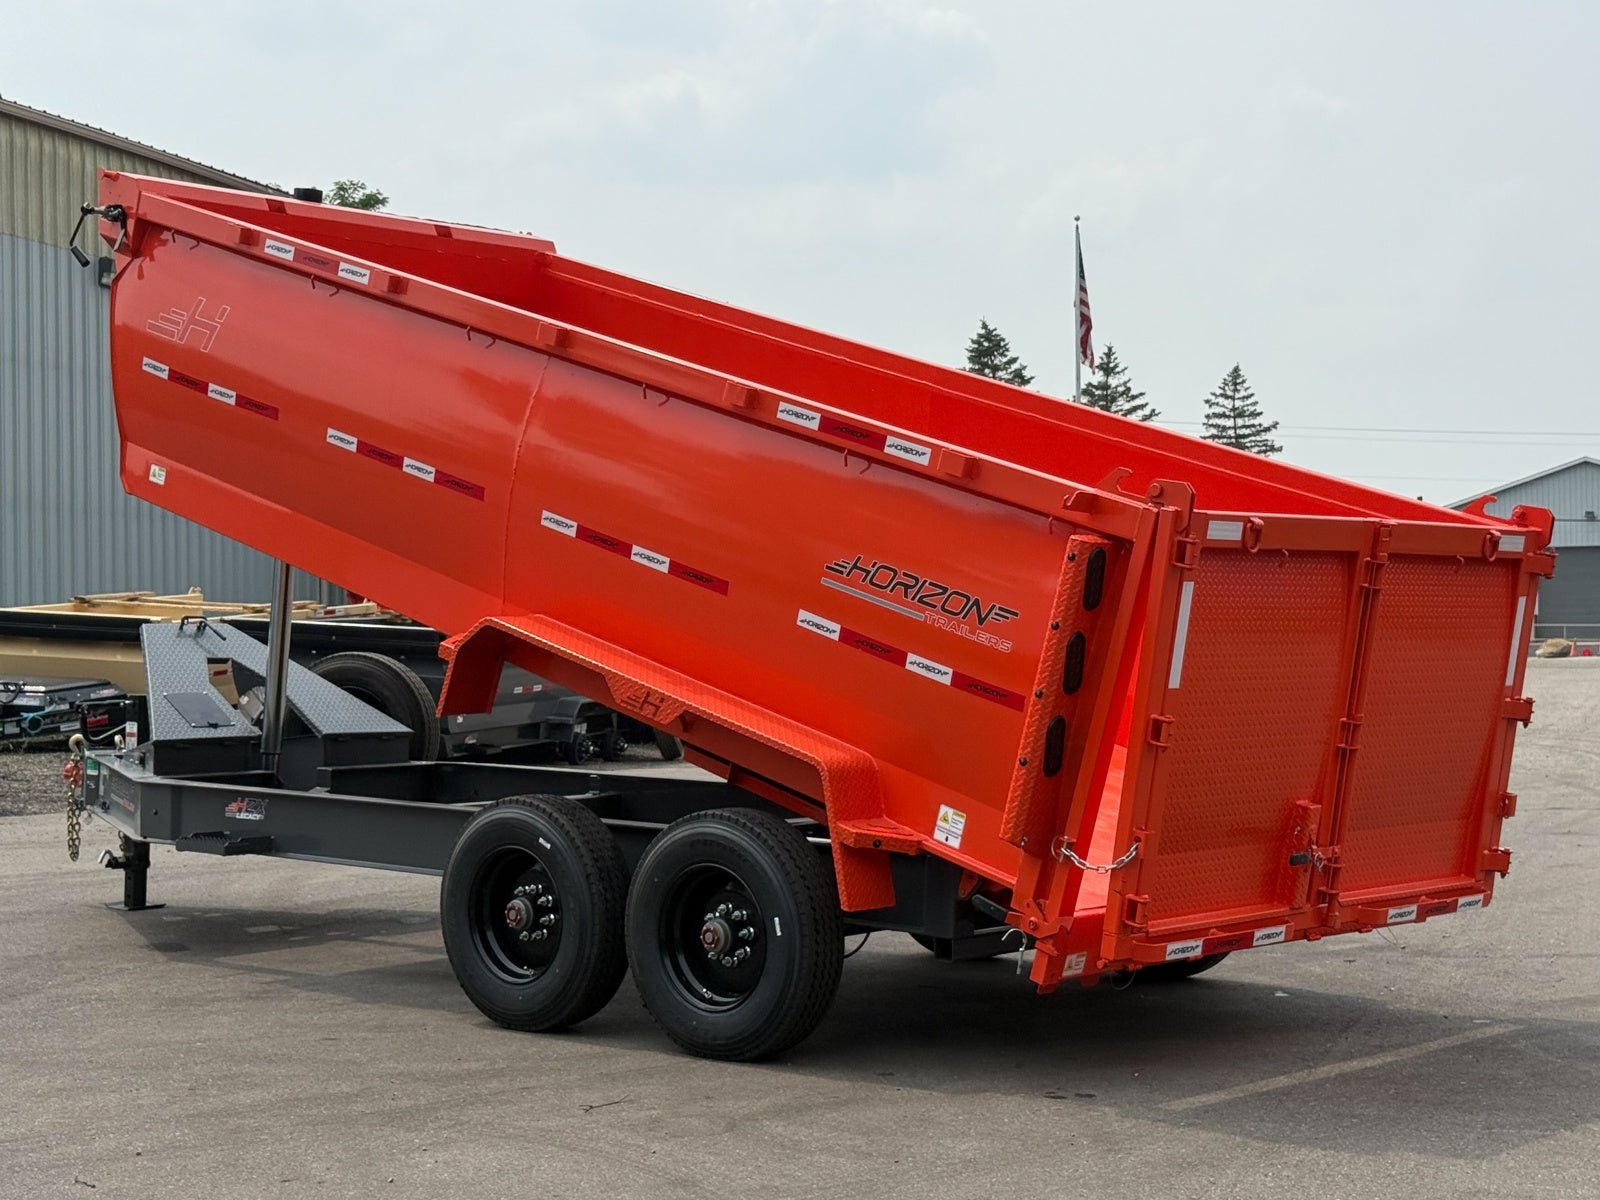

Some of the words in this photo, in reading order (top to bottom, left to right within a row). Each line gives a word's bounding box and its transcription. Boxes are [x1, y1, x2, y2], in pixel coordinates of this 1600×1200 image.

[779, 407, 816, 422] HORIZON
[887, 443, 927, 457] HORIZON
[633, 551, 666, 565] HORIZON
[842, 555, 1000, 626] HORIZON
[800, 618, 837, 634] HORIZON
[924, 611, 1012, 653] TRAILERS
[908, 659, 949, 676] HORIZON
